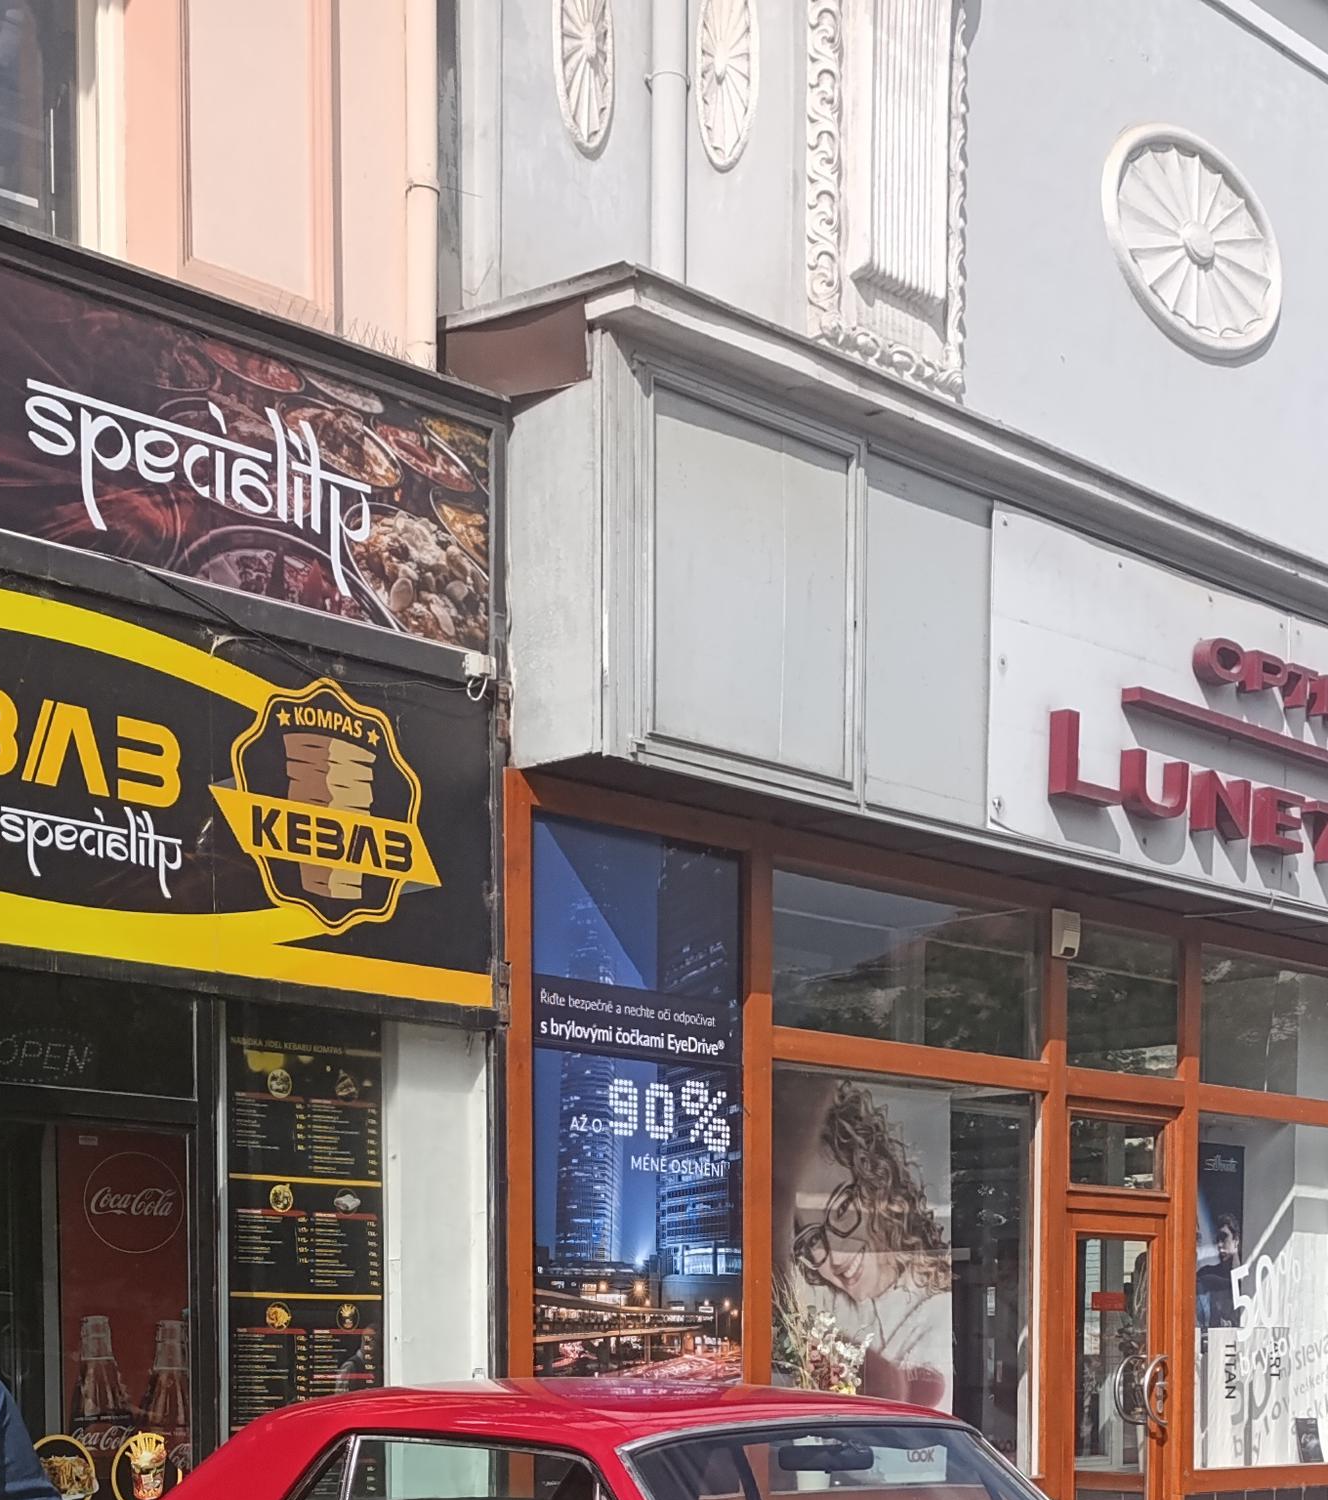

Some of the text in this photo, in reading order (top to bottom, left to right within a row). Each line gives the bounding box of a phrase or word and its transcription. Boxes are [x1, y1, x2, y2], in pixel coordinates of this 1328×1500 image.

[27, 379, 371, 597] speciality
[294, 706, 363, 739] KOMPAS
[1, 805, 183, 898] speciality
[250, 805, 414, 874] KEBAB
[568, 995, 613, 1013] bezpečně
[616, 1003, 622, 1015] a
[624, 1004, 655, 1019] nechte
[657, 1008, 671, 1020] oči
[540, 1021, 548, 1034] s
[550, 1018, 613, 1044] brýlovými
[615, 1027, 665, 1050] čočkami
[569, 1114, 602, 1133] AŽ O
[631, 1153, 668, 1172] MÉNĚ
[90, 1186, 176, 1216] Coca-Cola
[1224, 1344, 1237, 1400] TITAN
